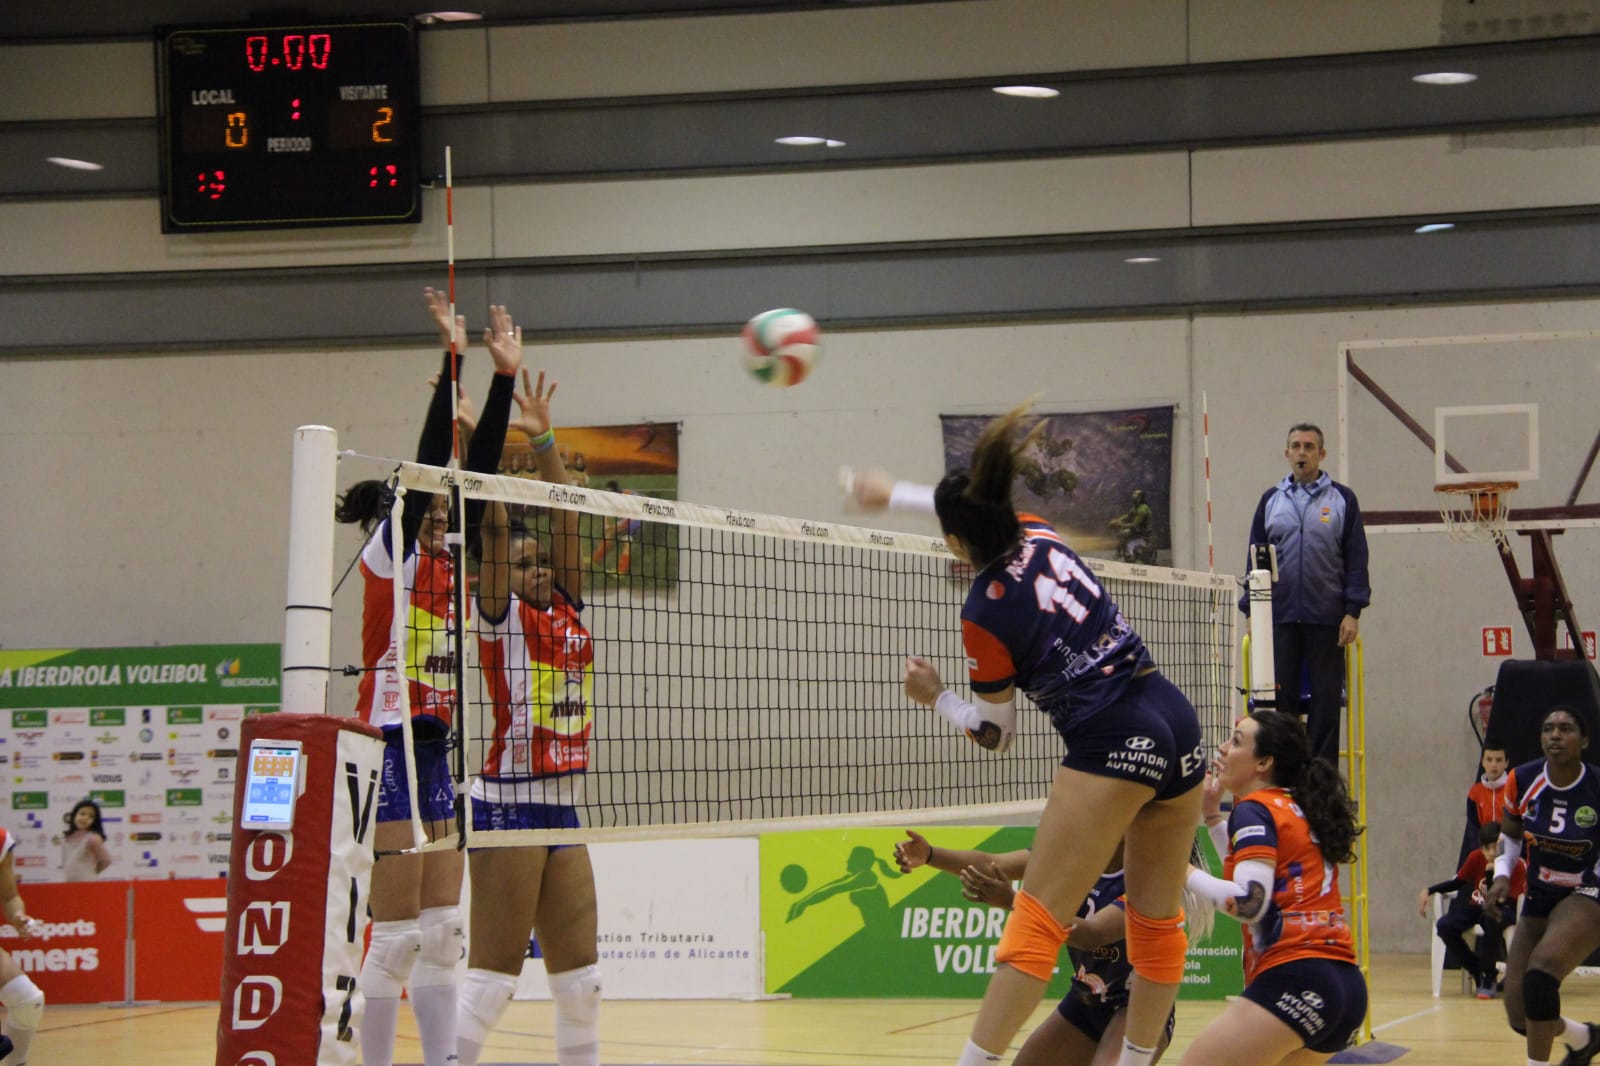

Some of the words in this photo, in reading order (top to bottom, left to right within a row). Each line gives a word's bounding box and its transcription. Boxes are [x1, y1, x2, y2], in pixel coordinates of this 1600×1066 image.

[191, 89, 235, 105] LOCAL
[372, 107, 393, 142] 2
[16, 664, 121, 688] IBERDROLA
[126, 663, 208, 684] VOLEIBOL
[1105, 760, 1136, 773] AUTO
[1548, 806, 1567, 834] 5
[901, 907, 1006, 938] IBERDR
[641, 932, 715, 943] Tributaria
[11, 947, 100, 973] mers
[664, 949, 680, 959] de
[688, 948, 750, 960] Alicante
